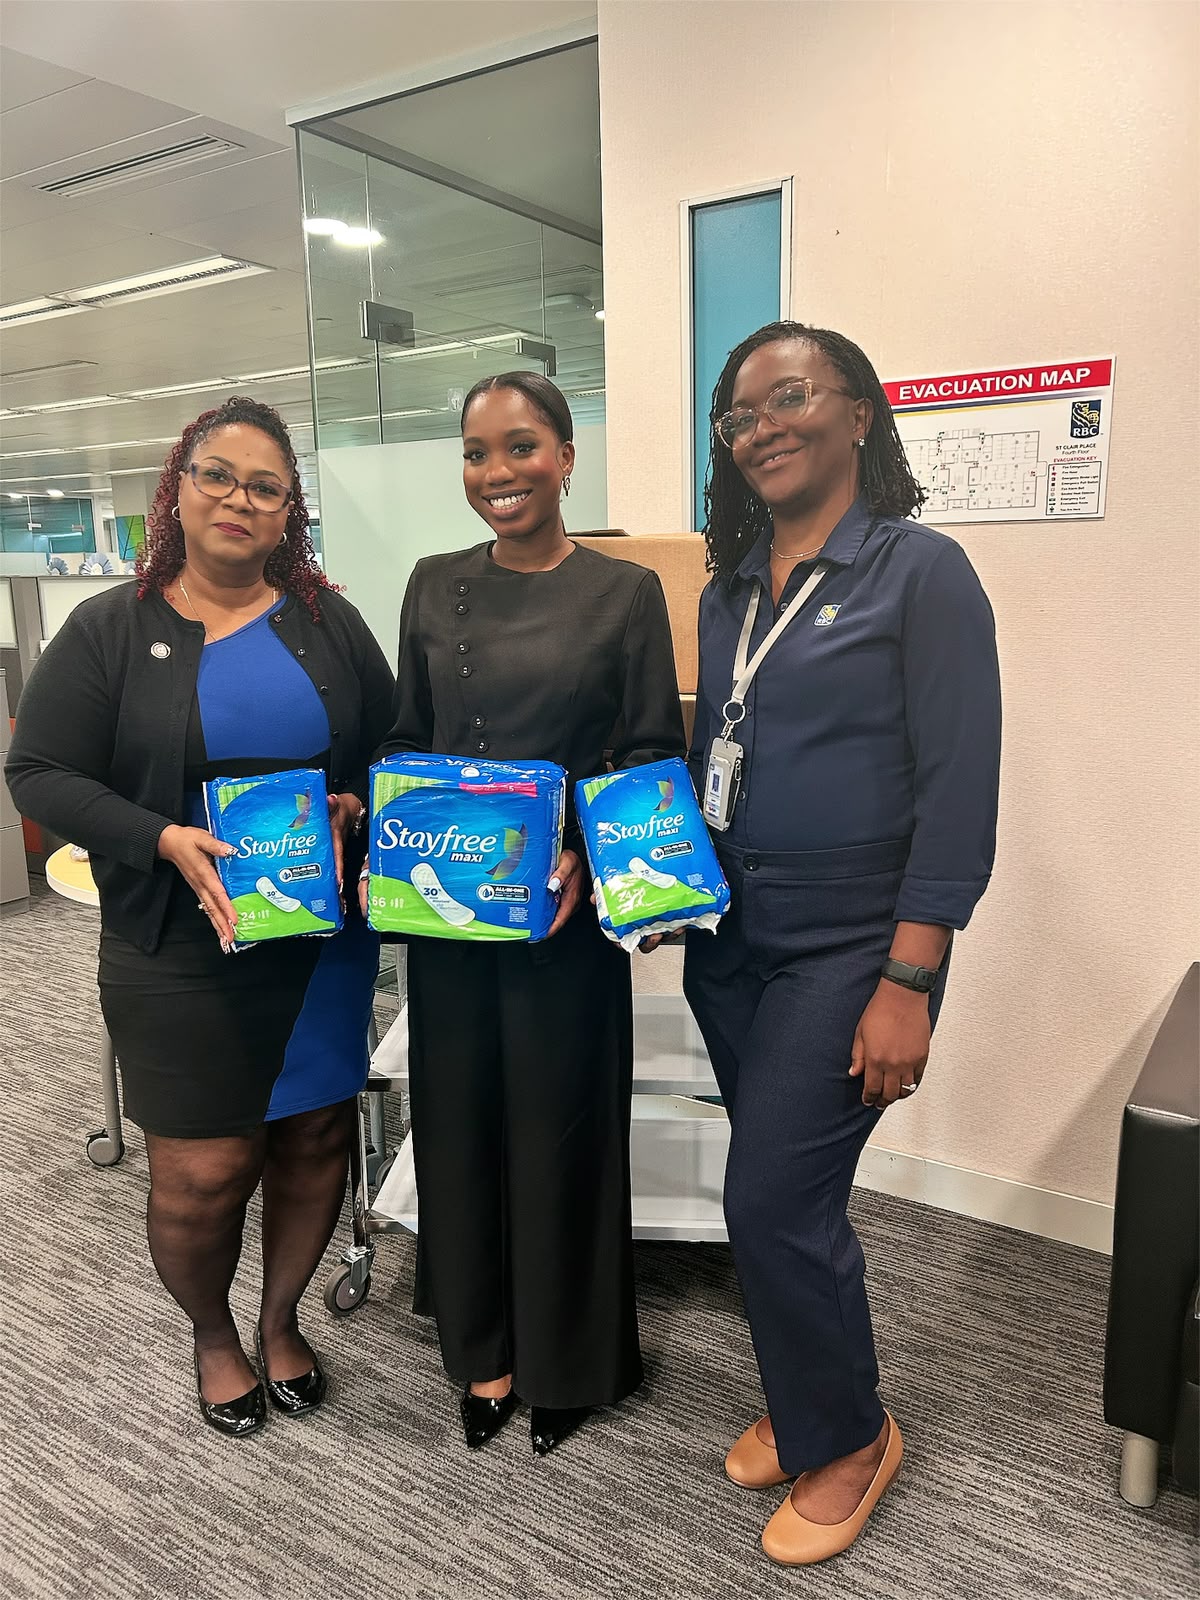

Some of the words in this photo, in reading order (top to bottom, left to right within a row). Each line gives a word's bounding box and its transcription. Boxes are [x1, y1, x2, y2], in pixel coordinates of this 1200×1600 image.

[899, 373, 1033, 400] EVACUATION
[1040, 367, 1091, 387] MAP
[1073, 427, 1098, 437] RBC
[605, 813, 685, 845] Stayfree
[657, 826, 679, 838] maxi
[376, 818, 498, 858] Stayfree
[236, 832, 317, 859] Stayfree
[288, 849, 310, 858] maxi
[450, 852, 484, 863] maxi
[241, 912, 256, 922] 24
